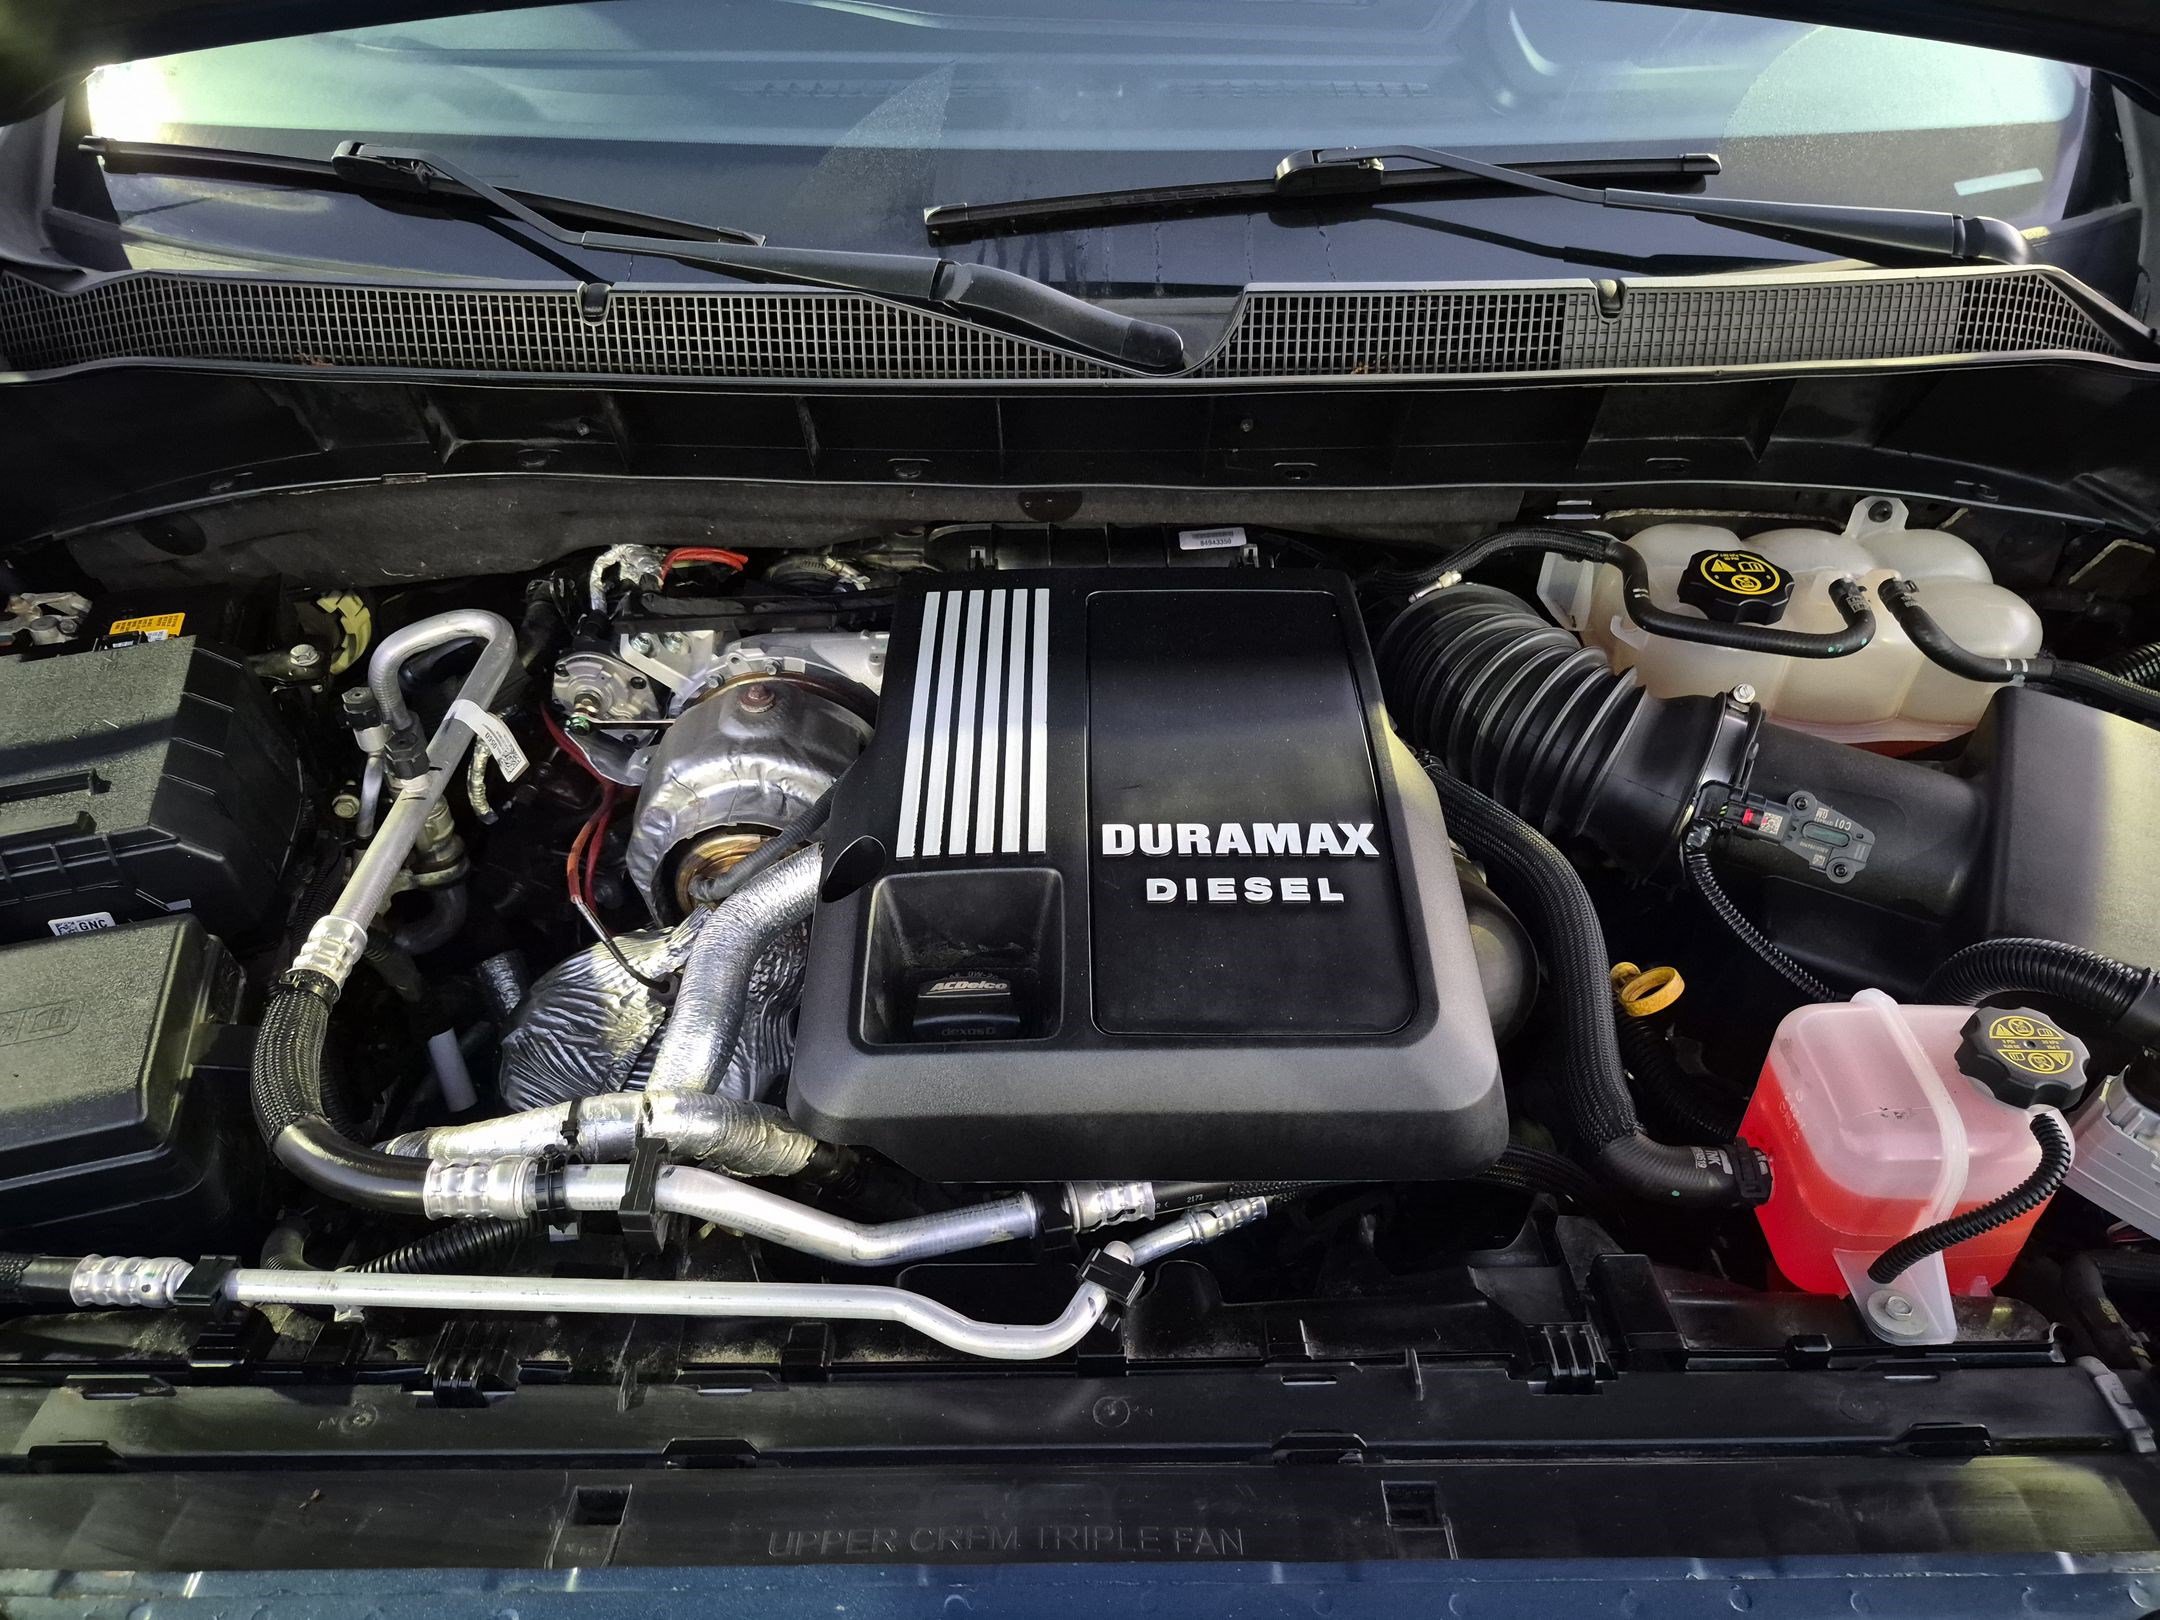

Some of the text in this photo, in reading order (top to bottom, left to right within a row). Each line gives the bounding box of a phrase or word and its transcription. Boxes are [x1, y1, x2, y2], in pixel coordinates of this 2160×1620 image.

[1102, 823, 1380, 856] DURAMAX
[1146, 877, 1345, 903] DIESEL
[79, 920, 107, 930] GNC
[930, 981, 1008, 992] ACDelco
[769, 1527, 897, 1556] UPPER
[1034, 1525, 1161, 1552] TRIPLE
[1175, 1526, 1244, 1555] FAN
